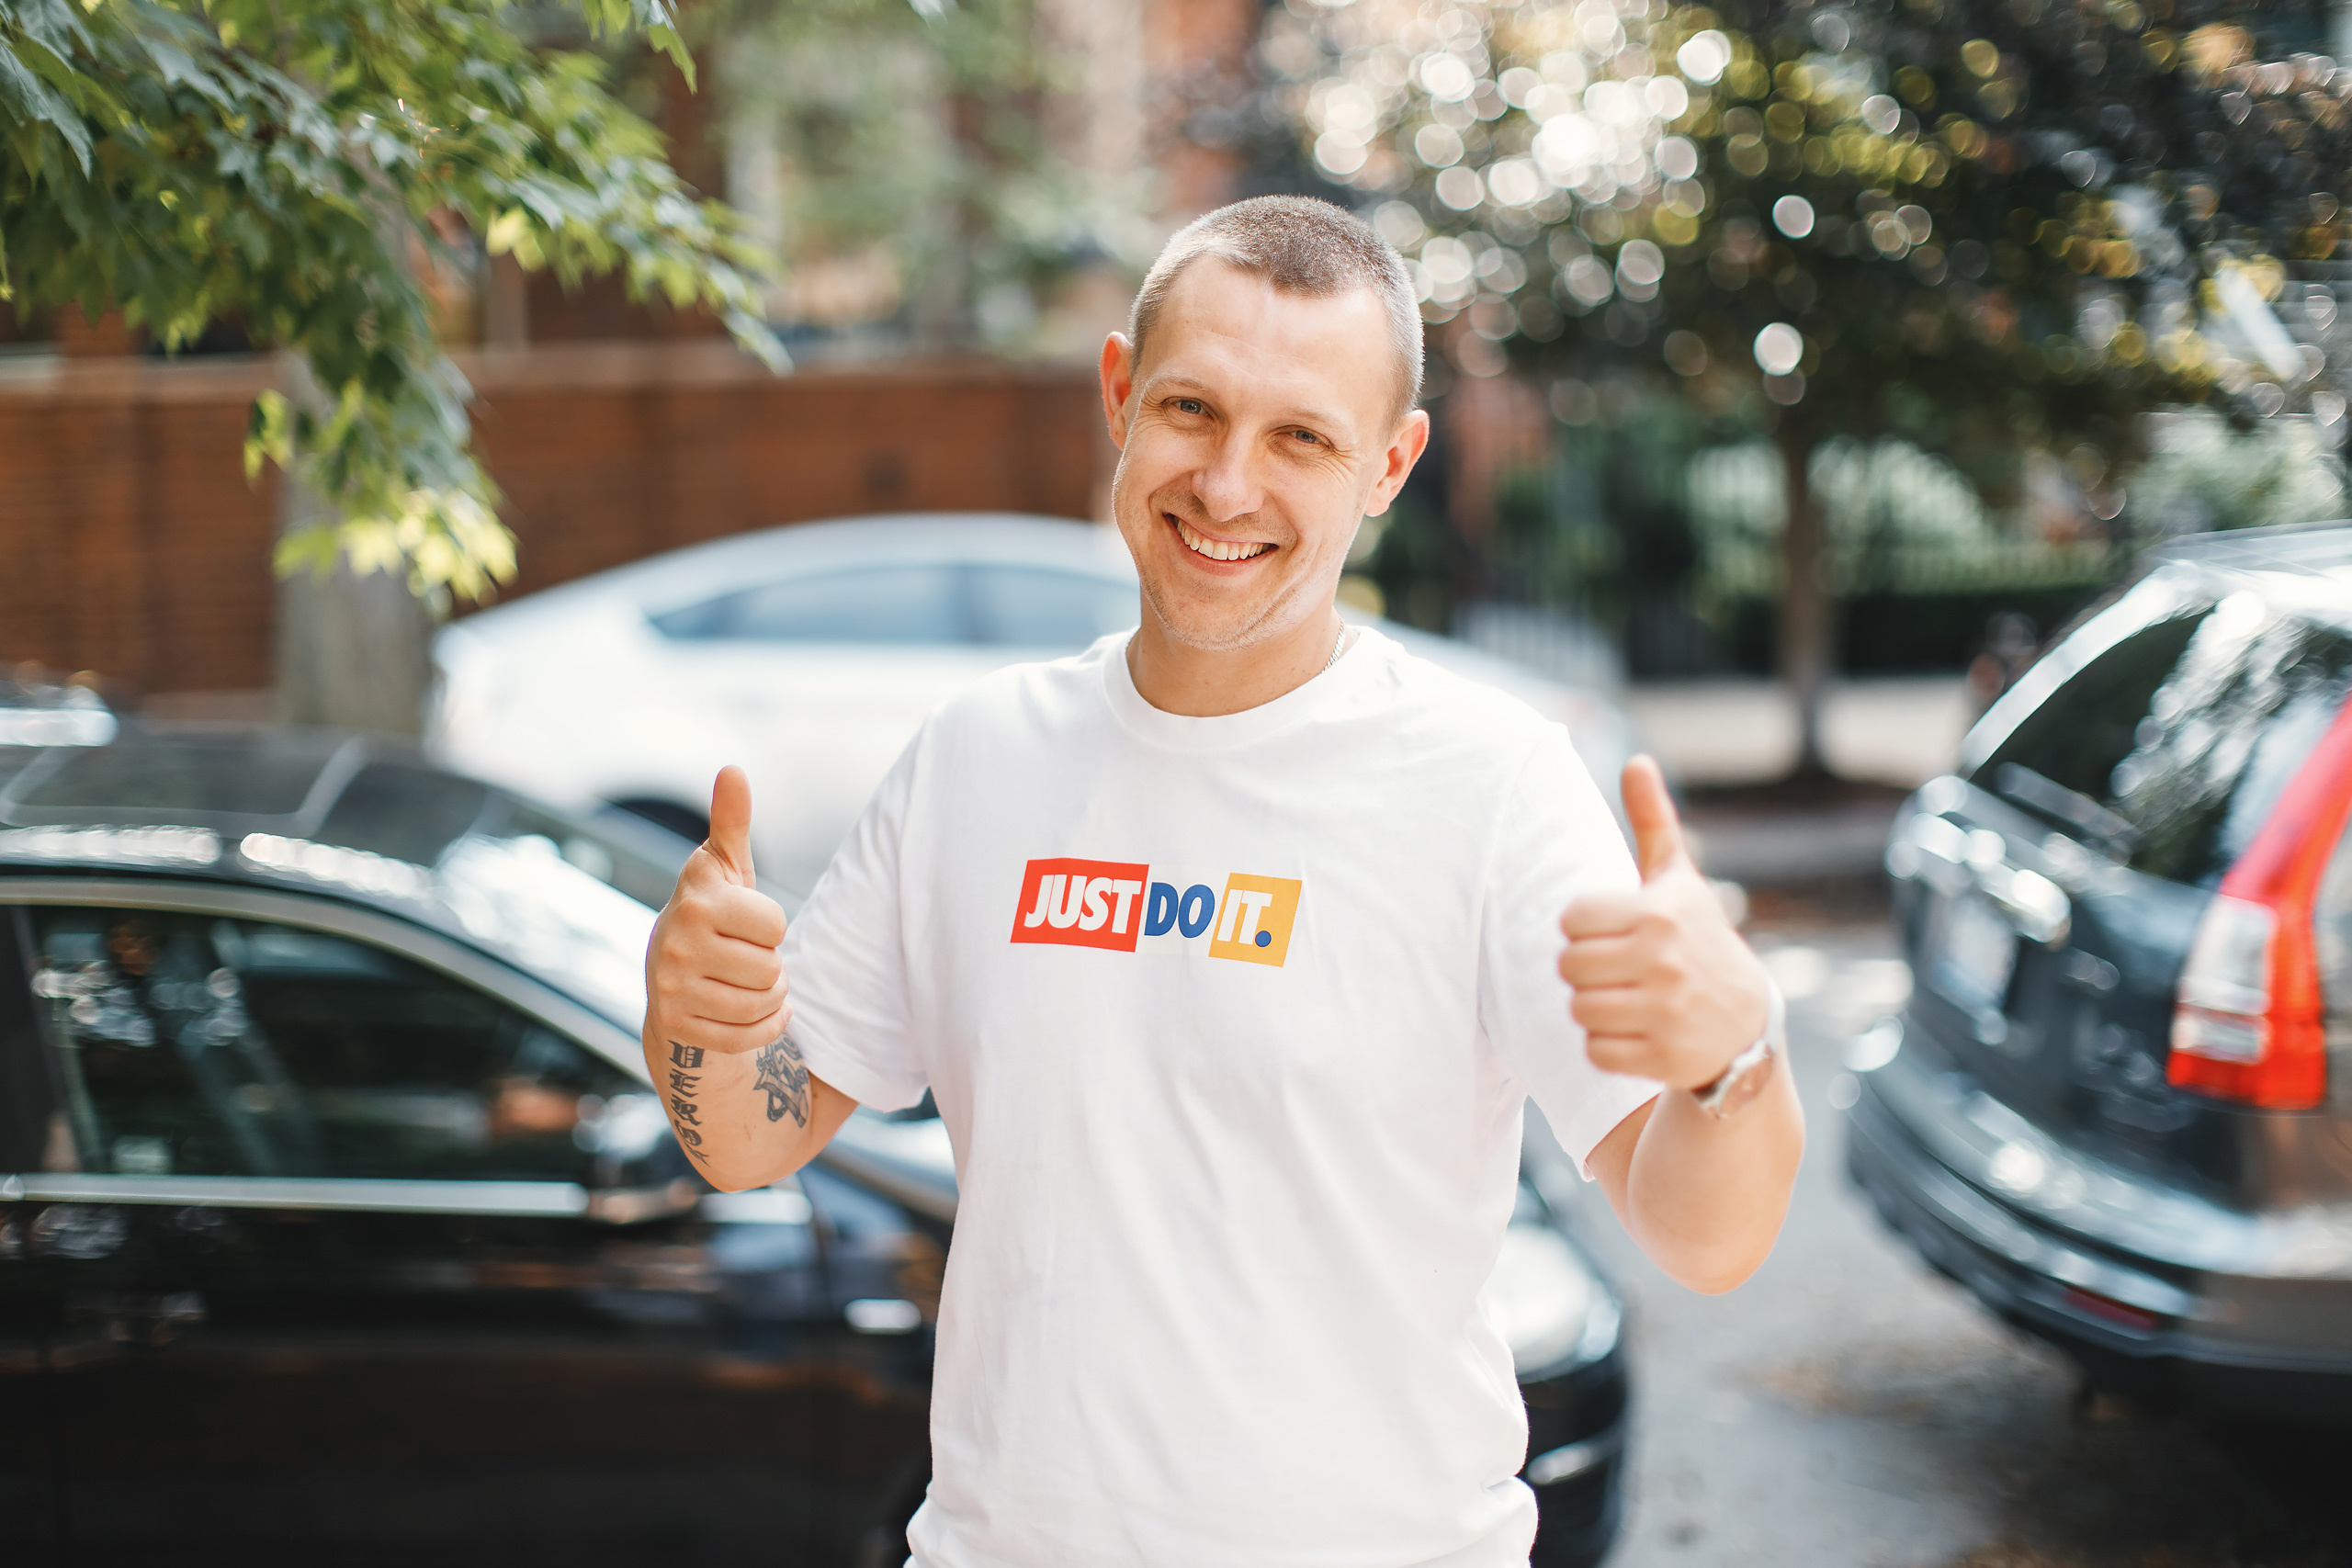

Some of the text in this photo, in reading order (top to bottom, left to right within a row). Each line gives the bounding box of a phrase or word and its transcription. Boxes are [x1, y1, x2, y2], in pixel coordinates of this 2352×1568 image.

[1023, 874, 1273, 948] JUST DO IT.
